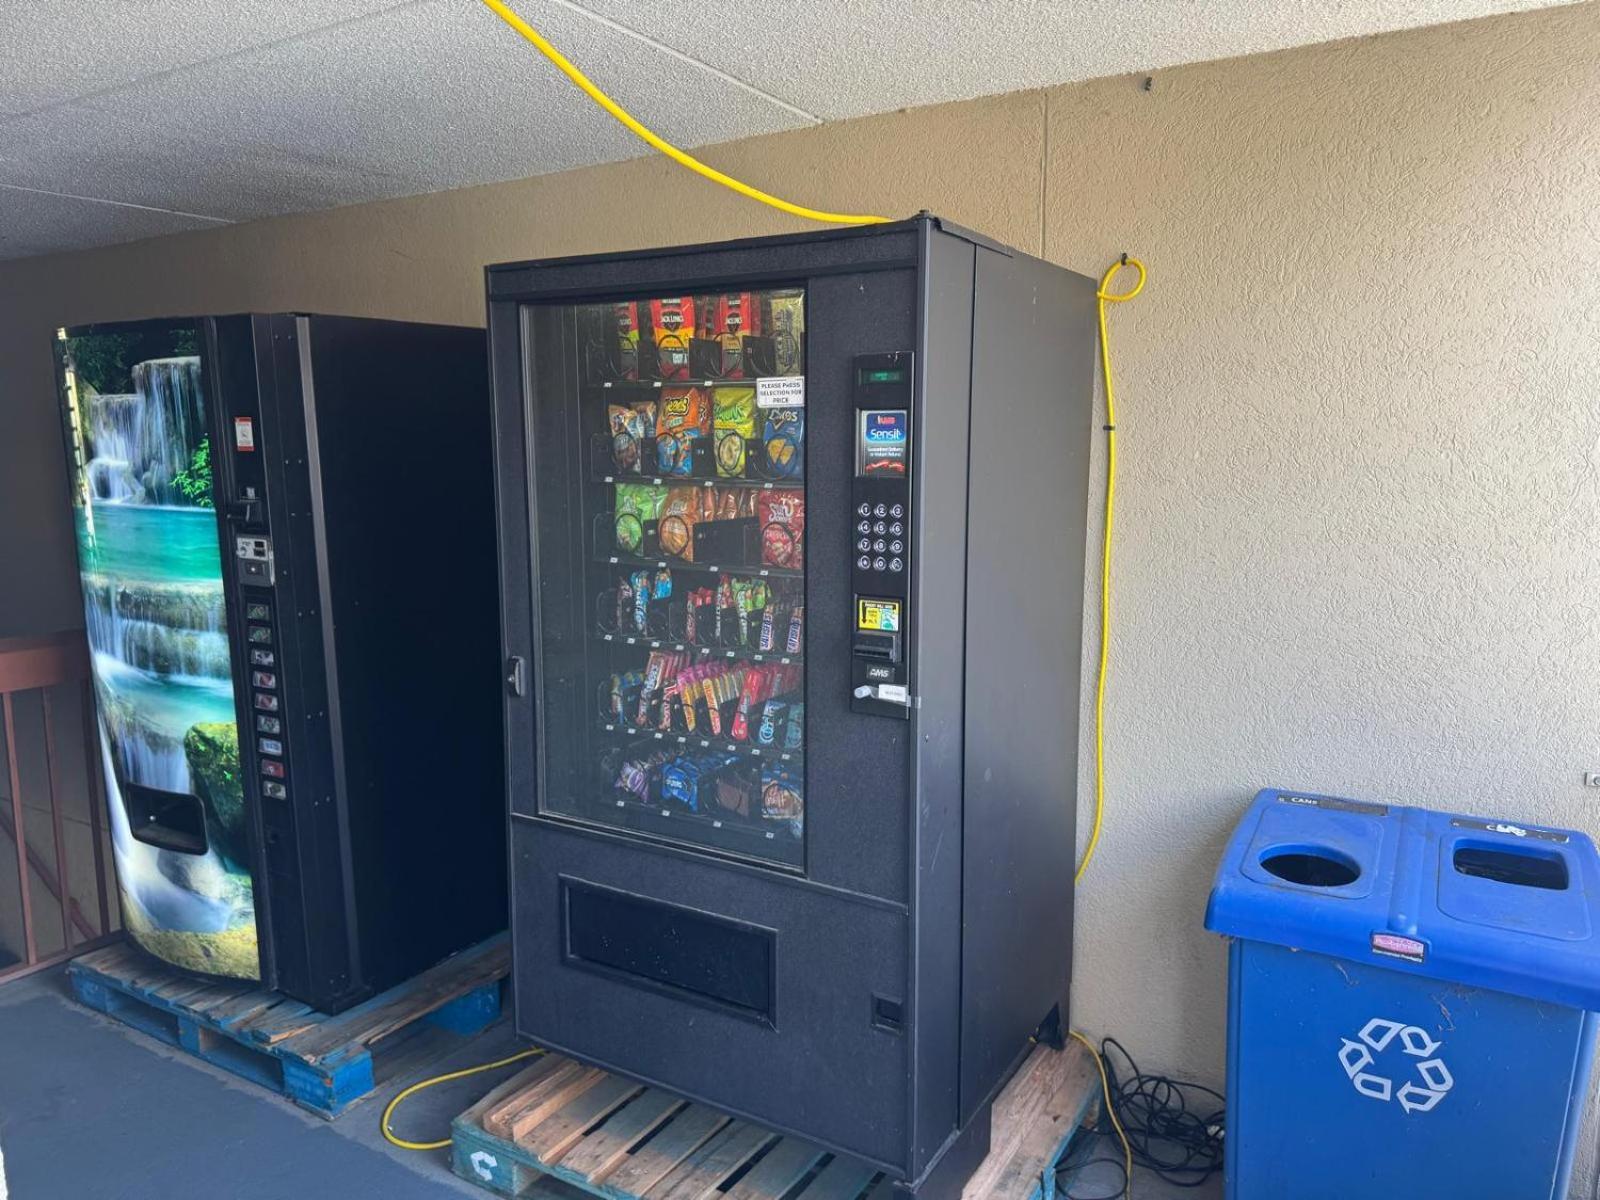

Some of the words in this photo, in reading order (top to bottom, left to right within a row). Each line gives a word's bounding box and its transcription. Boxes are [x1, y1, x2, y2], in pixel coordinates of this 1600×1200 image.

[870, 428, 902, 440] Sensit
[869, 668, 889, 678] AMS
[1291, 797, 1318, 805] CANS
